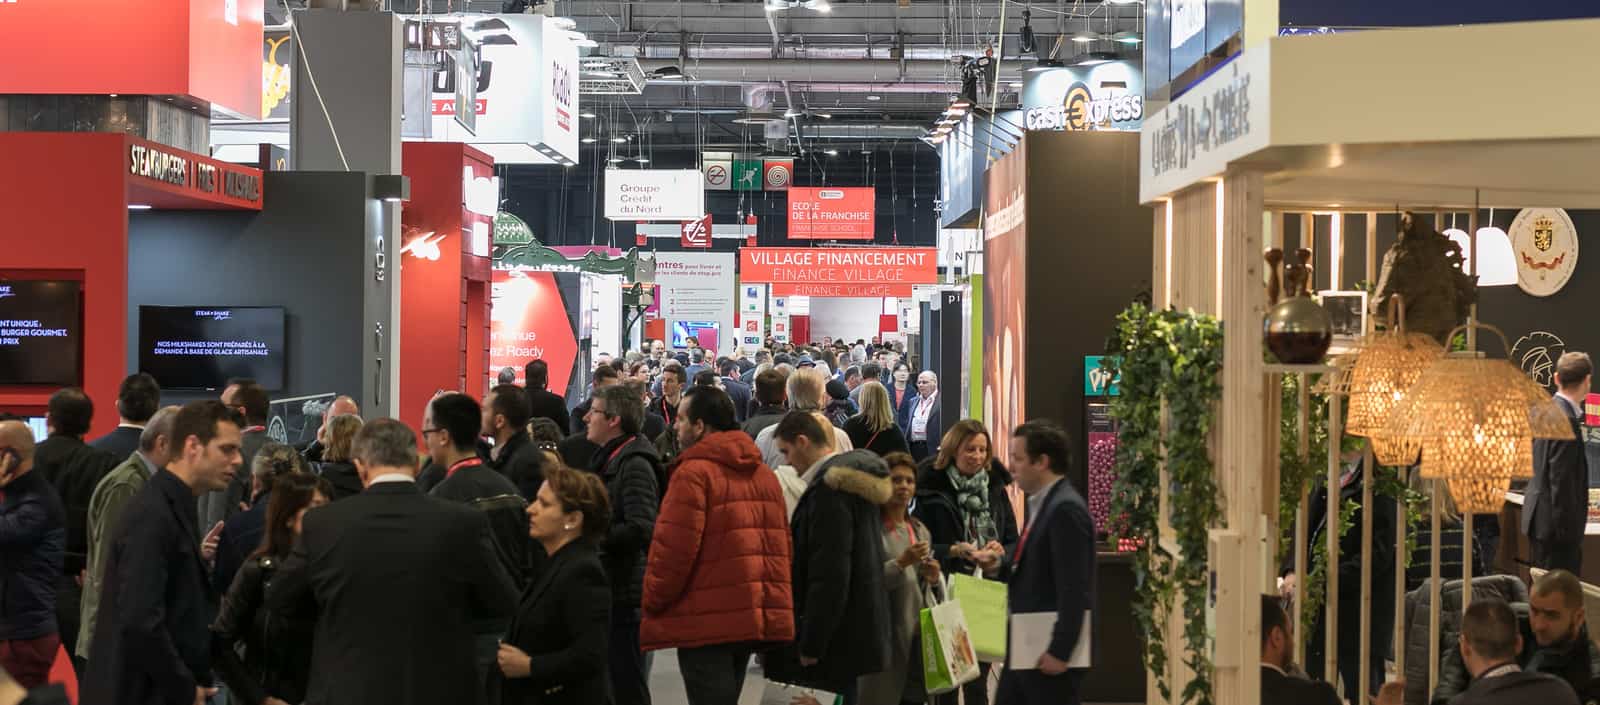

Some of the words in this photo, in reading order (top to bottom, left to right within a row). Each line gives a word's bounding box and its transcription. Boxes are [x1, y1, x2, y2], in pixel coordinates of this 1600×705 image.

[131, 143, 186, 186] STEAKBURGERS
[619, 184, 661, 194] Groupe
[619, 205, 634, 213] du
[636, 205, 662, 213] Nord
[792, 202, 820, 210] ECOLE
[792, 212, 804, 220] DE
[807, 212, 818, 220] LA
[821, 211, 870, 220] FRANCHISE
[750, 252, 813, 265] VILLAGE
[817, 252, 927, 265] FINANCEMENT
[773, 268, 836, 281] FINANCE
[844, 268, 905, 281] VILLAGE
[795, 285, 841, 296] FINANCE
[847, 285, 891, 296] VILLAGE
[233, 348, 269, 356] ARTISANALE
[506, 346, 543, 359] Roady
